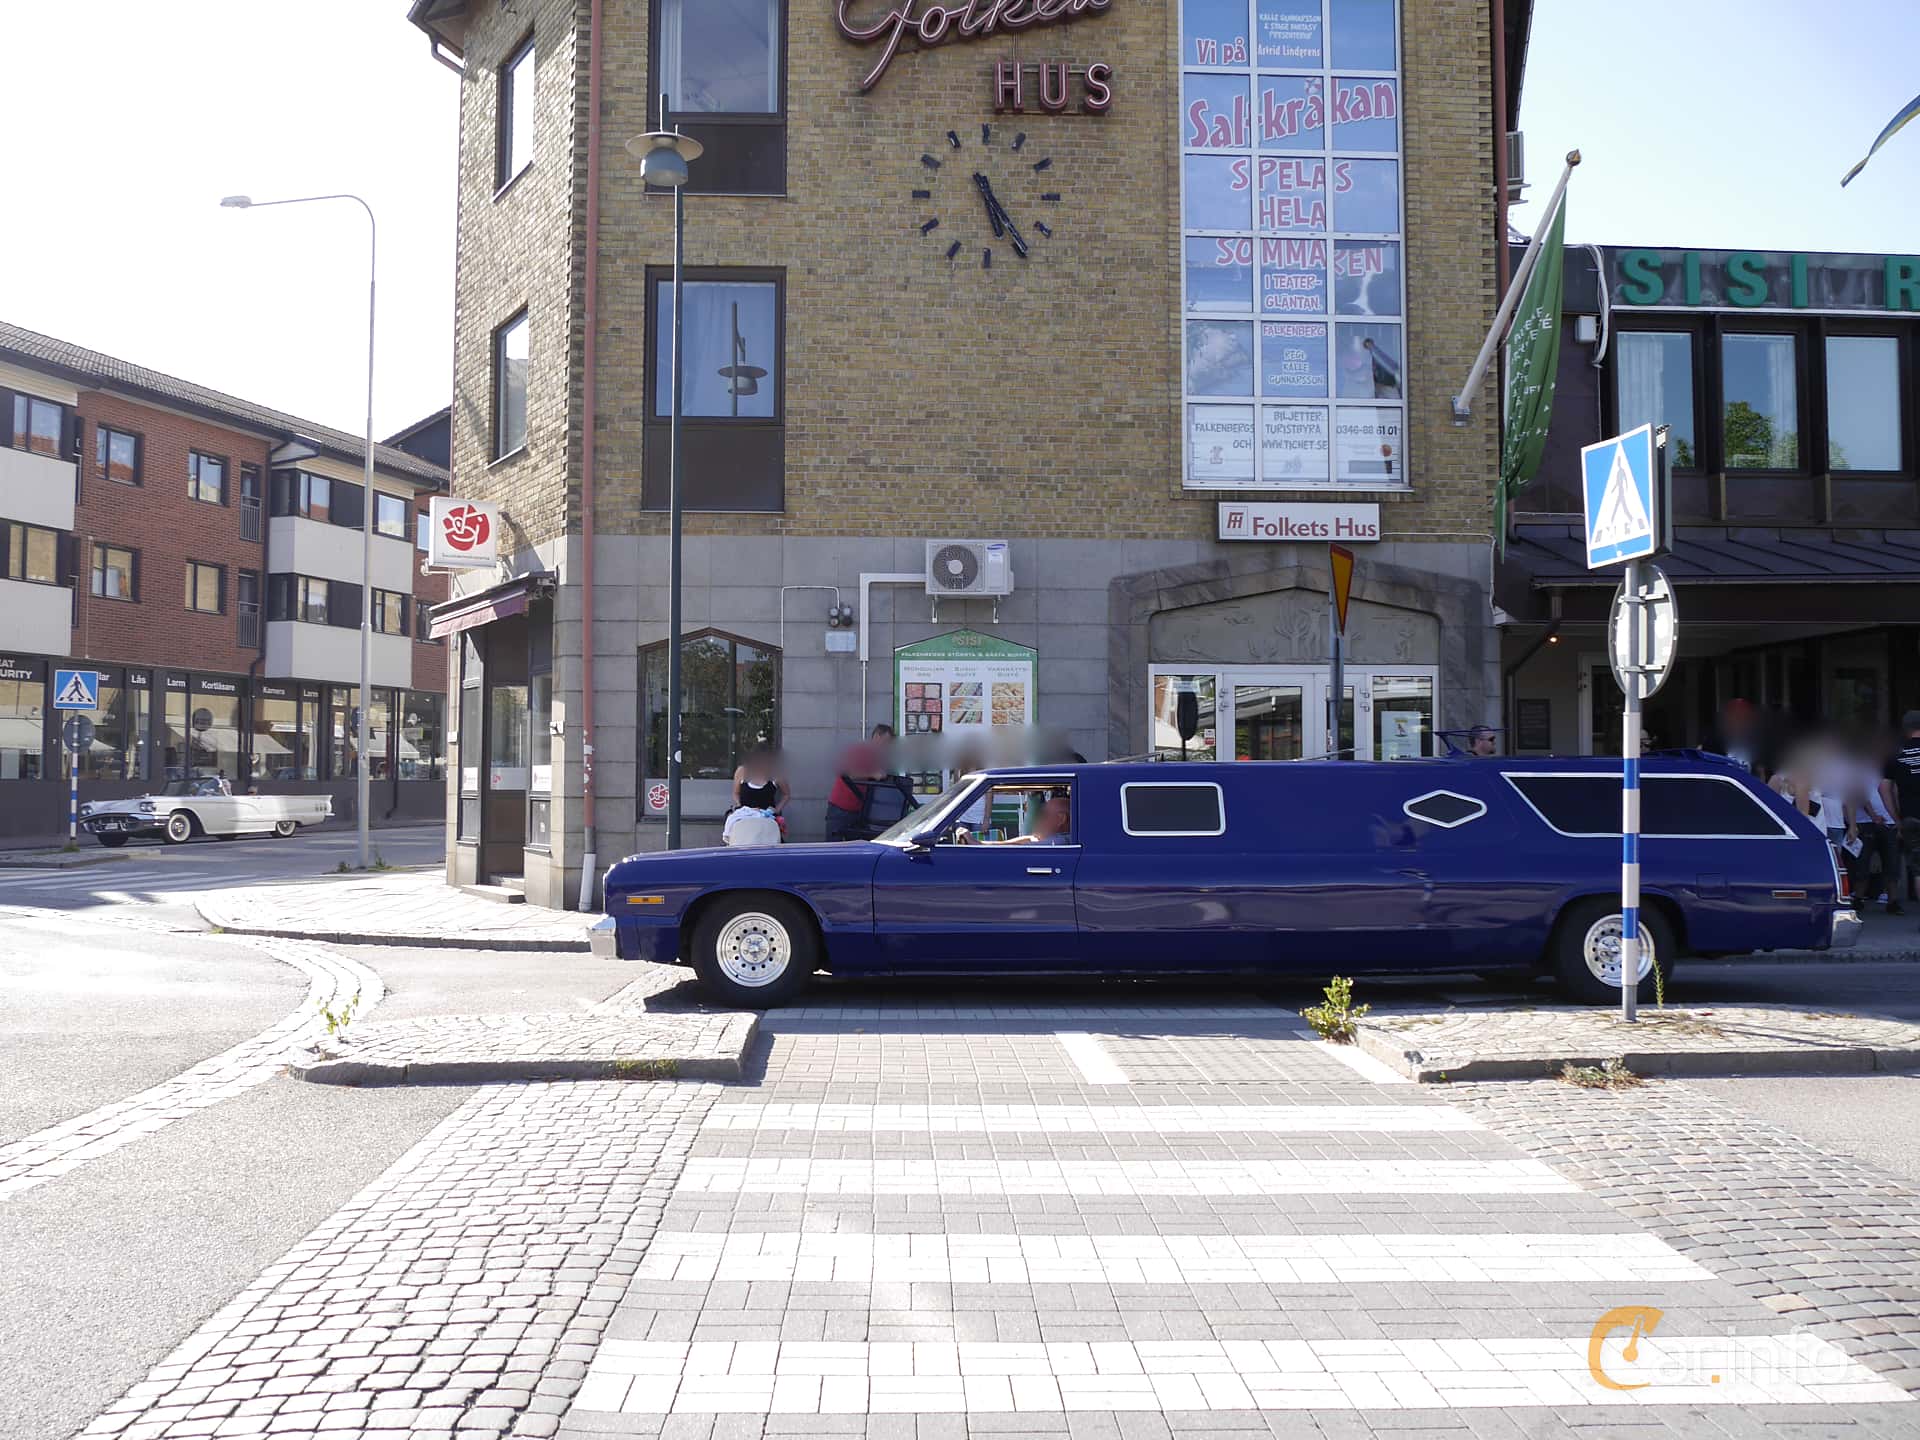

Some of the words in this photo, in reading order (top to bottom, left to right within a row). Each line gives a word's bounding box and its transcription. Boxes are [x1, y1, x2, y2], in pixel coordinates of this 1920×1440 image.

[1196, 38, 1217, 64] Vi
[1222, 37, 1246, 64] på
[993, 60, 1113, 114] HUS
[1231, 158, 1353, 192] SPELAS
[1258, 196, 1326, 228] HELA
[1620, 249, 1809, 308] SISI
[1232, 438, 1252, 449] OCH
[1252, 516, 1329, 537] Folkets
[1335, 517, 1376, 537] Hus
[167, 677, 186, 688] Larm
